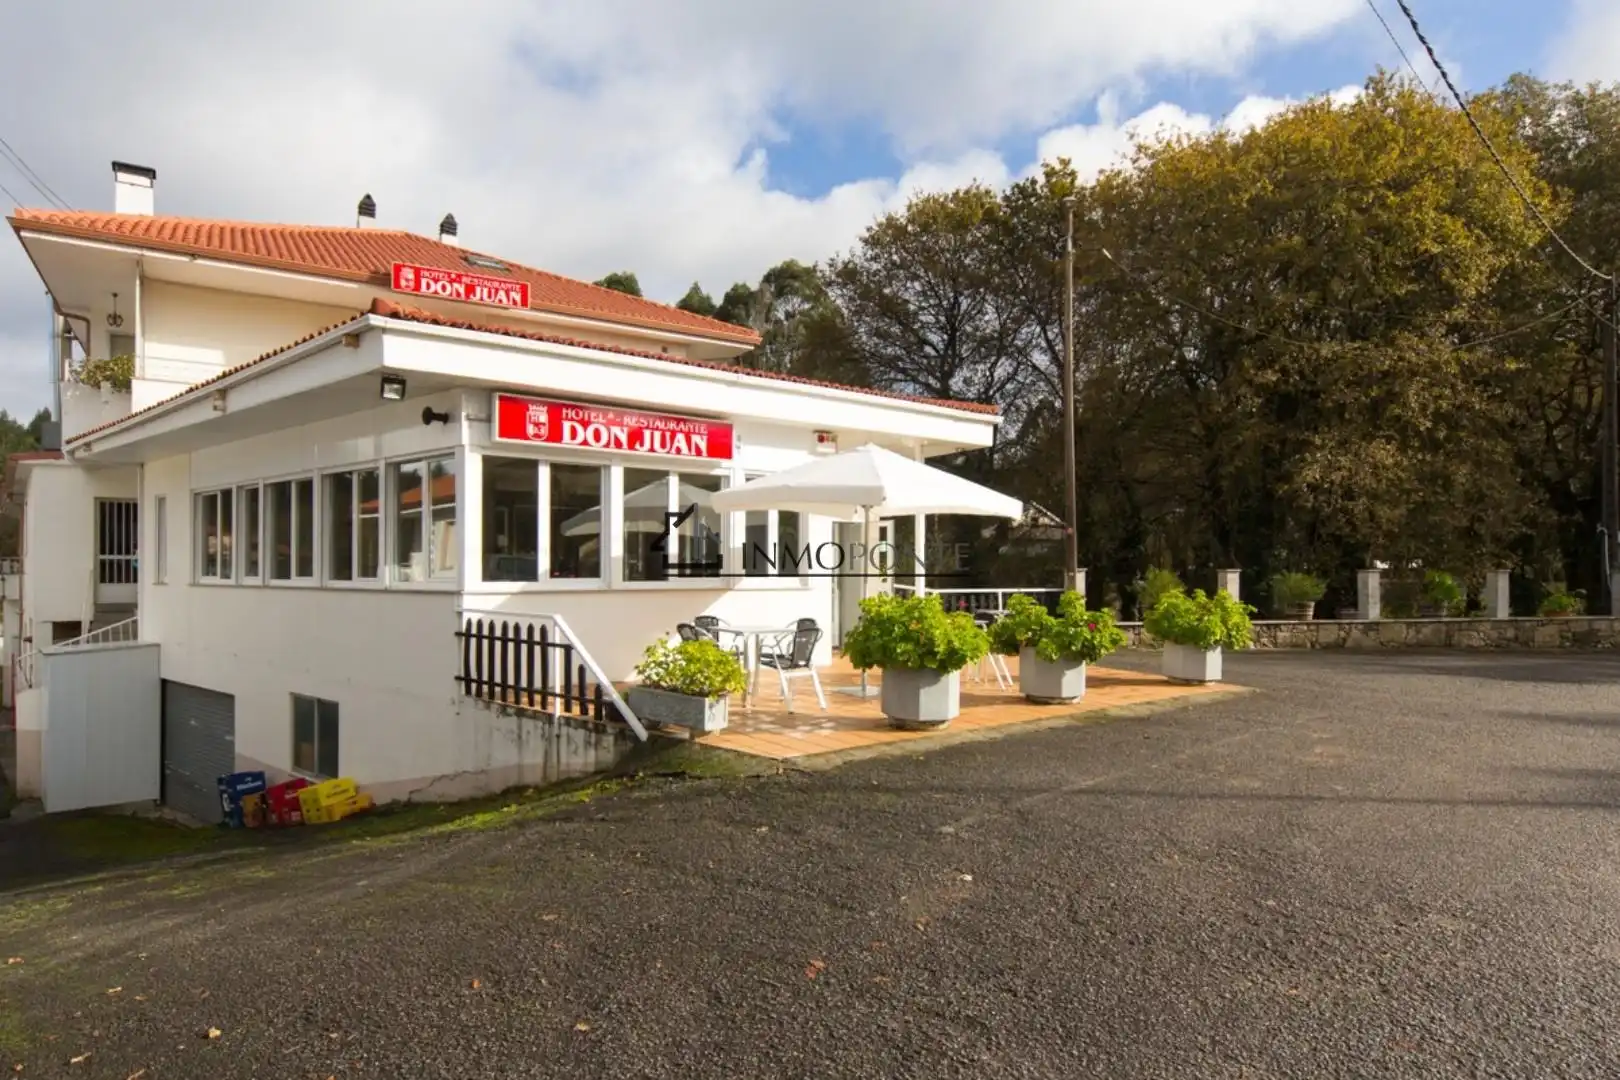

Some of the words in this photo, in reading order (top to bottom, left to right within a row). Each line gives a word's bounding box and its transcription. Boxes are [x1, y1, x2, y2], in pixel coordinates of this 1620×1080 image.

[420, 269, 450, 280] HOTEL
[420, 277, 465, 299] DON
[470, 285, 521, 307] JUAN
[562, 407, 606, 423] HOTEL
[624, 415, 708, 434] RESTAURANTE
[561, 420, 628, 449] DON
[634, 429, 708, 457] JUAN
